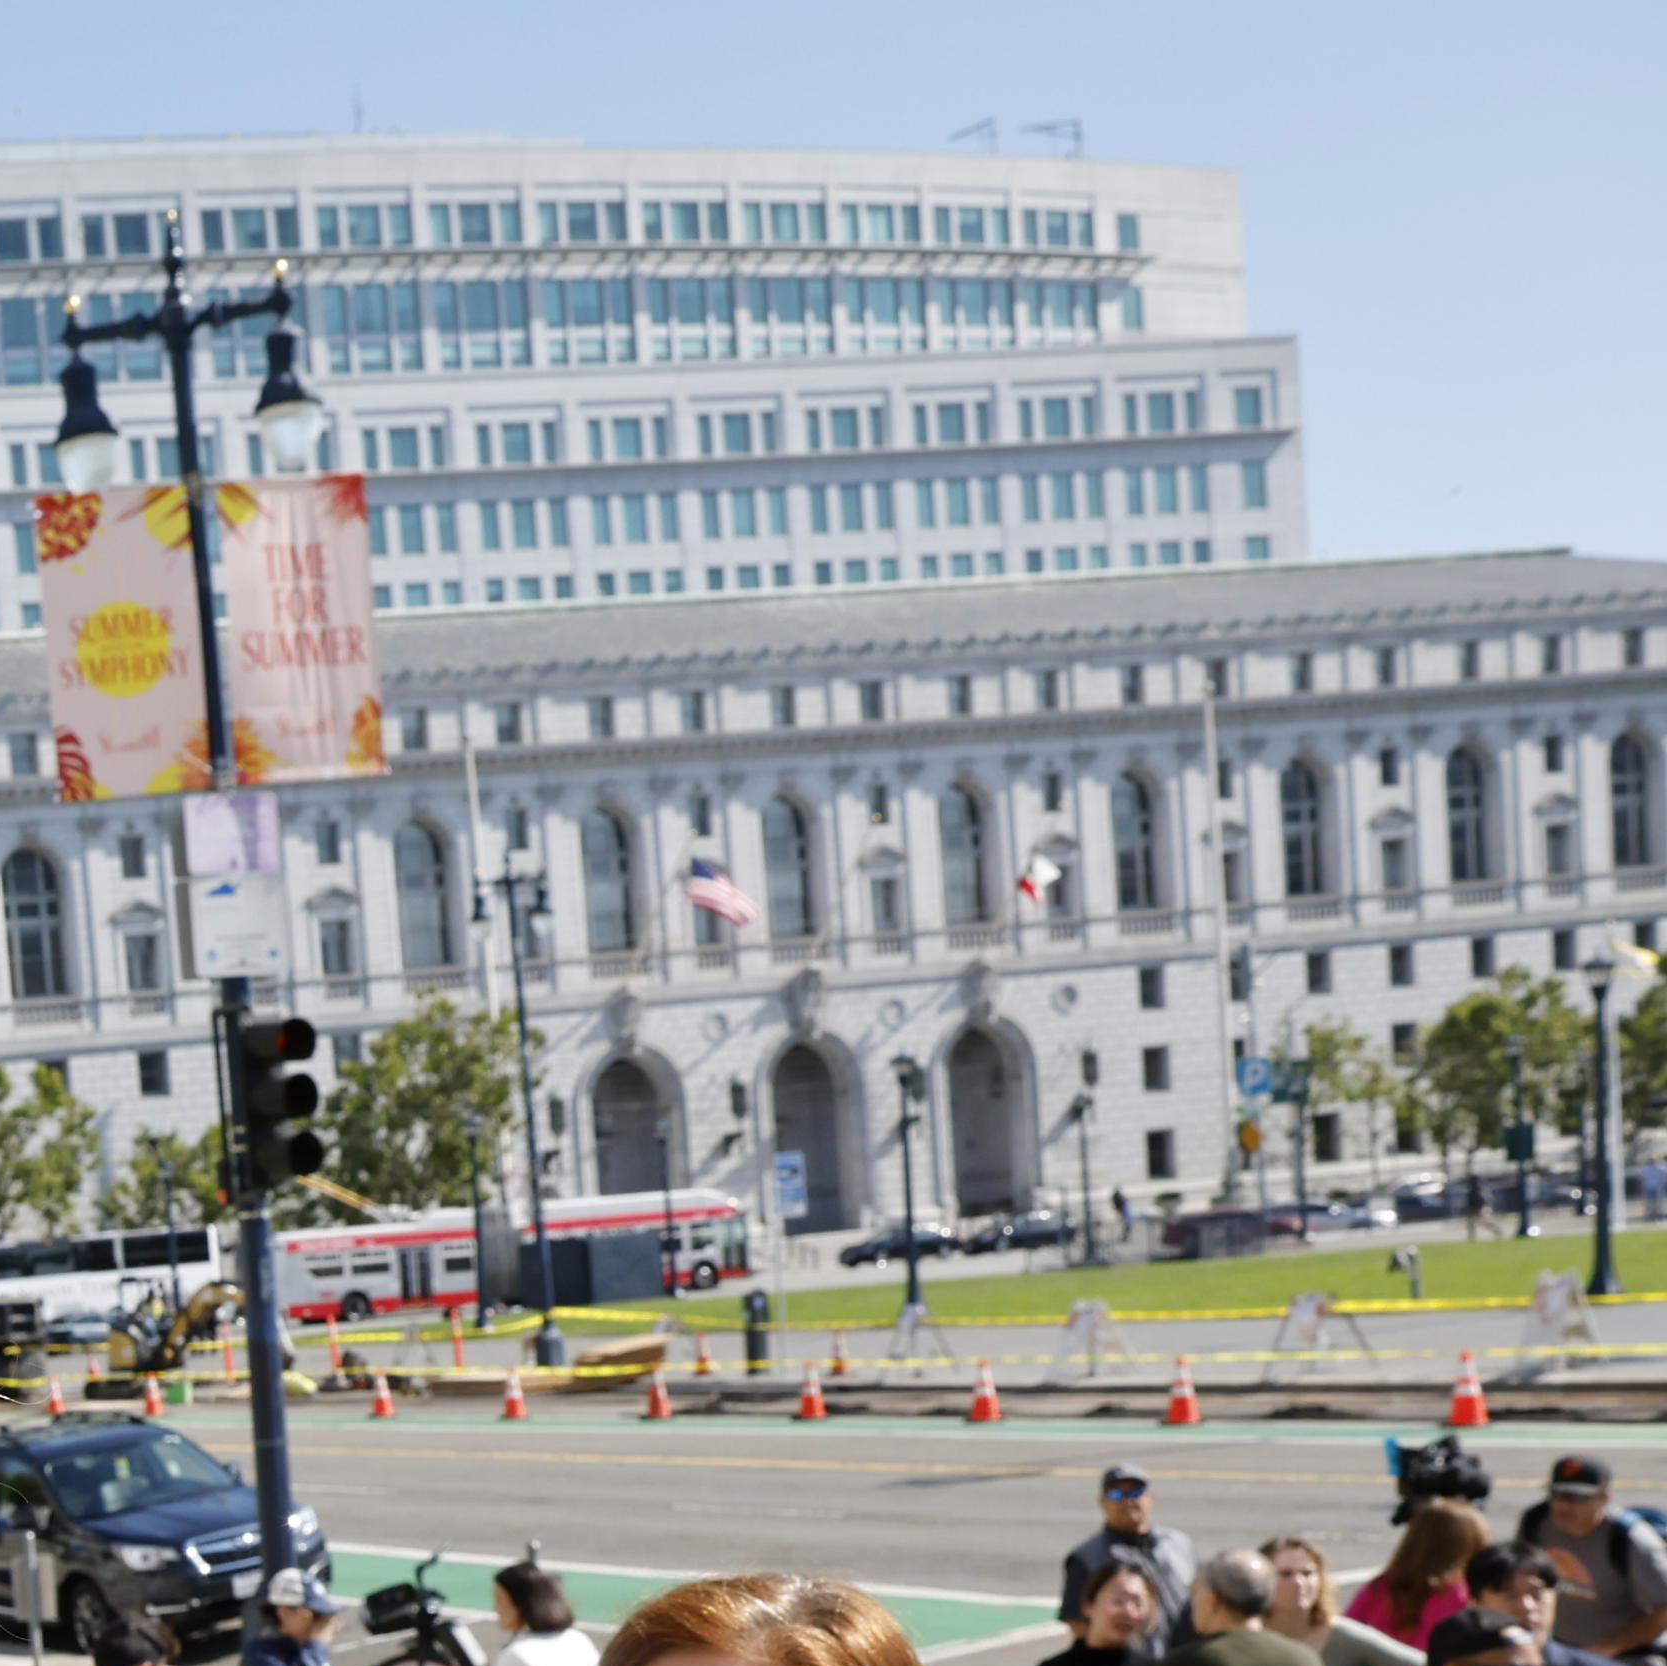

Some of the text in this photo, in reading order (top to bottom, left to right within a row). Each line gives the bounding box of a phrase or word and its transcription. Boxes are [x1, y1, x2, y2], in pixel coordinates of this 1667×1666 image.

[263, 542, 327, 582] TIME
[68, 607, 176, 638] SUMMER
[271, 586, 329, 623] FOR
[58, 649, 191, 690] SYMPHONY
[240, 629, 367, 672] SUMMER
